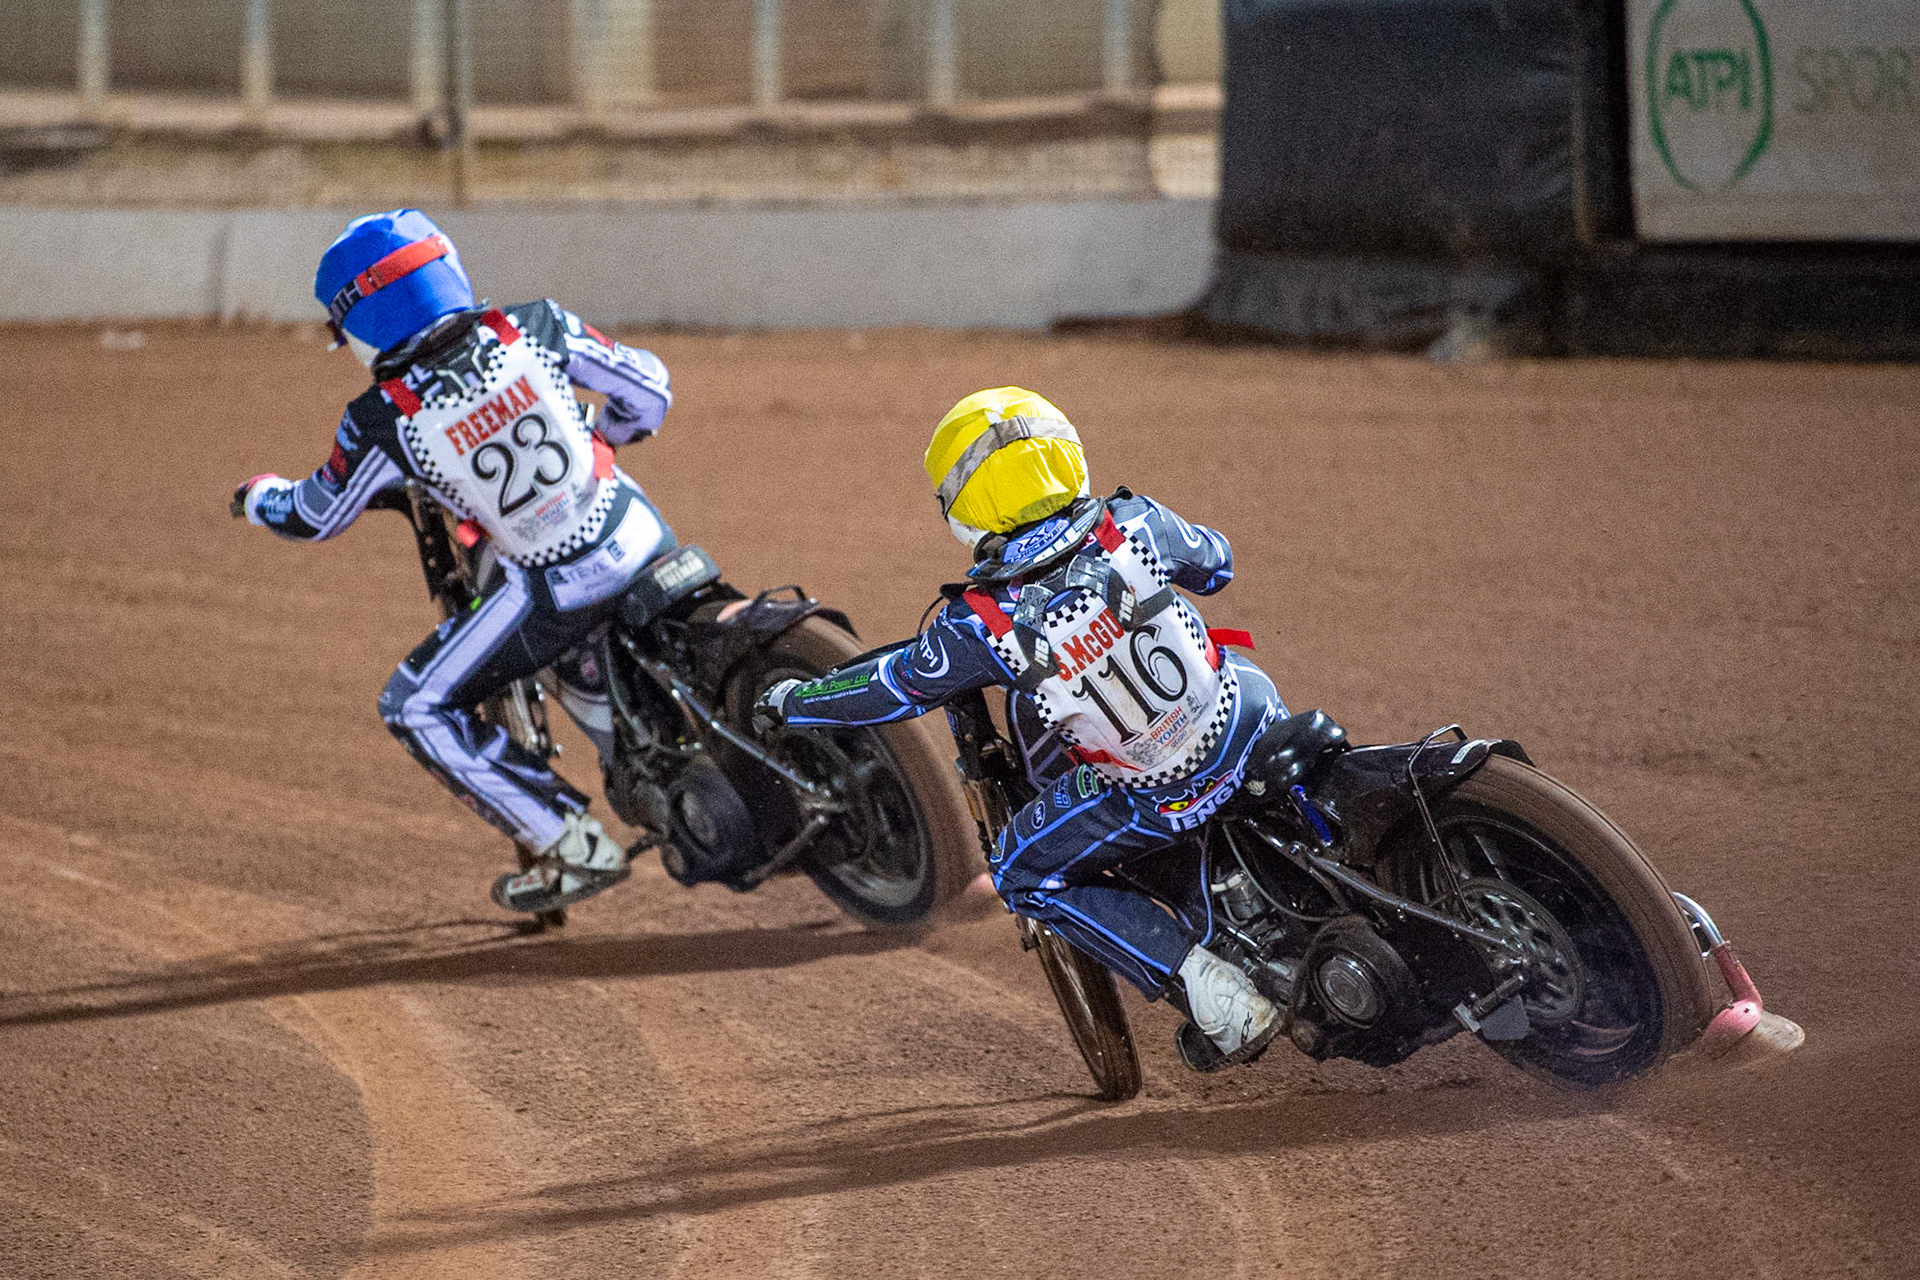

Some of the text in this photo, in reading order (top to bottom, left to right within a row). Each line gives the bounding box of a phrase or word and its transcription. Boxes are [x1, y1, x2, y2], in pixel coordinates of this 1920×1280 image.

[1664, 45, 1920, 114] ATPI SPOR
[445, 374, 539, 456] FREEMAN
[471, 413, 571, 518] 23
[1053, 608, 1125, 681] S.McGU
[1072, 624, 1188, 747] 116
[1150, 706, 1183, 740] BRITISH
[1156, 713, 1188, 745] YOUTH
